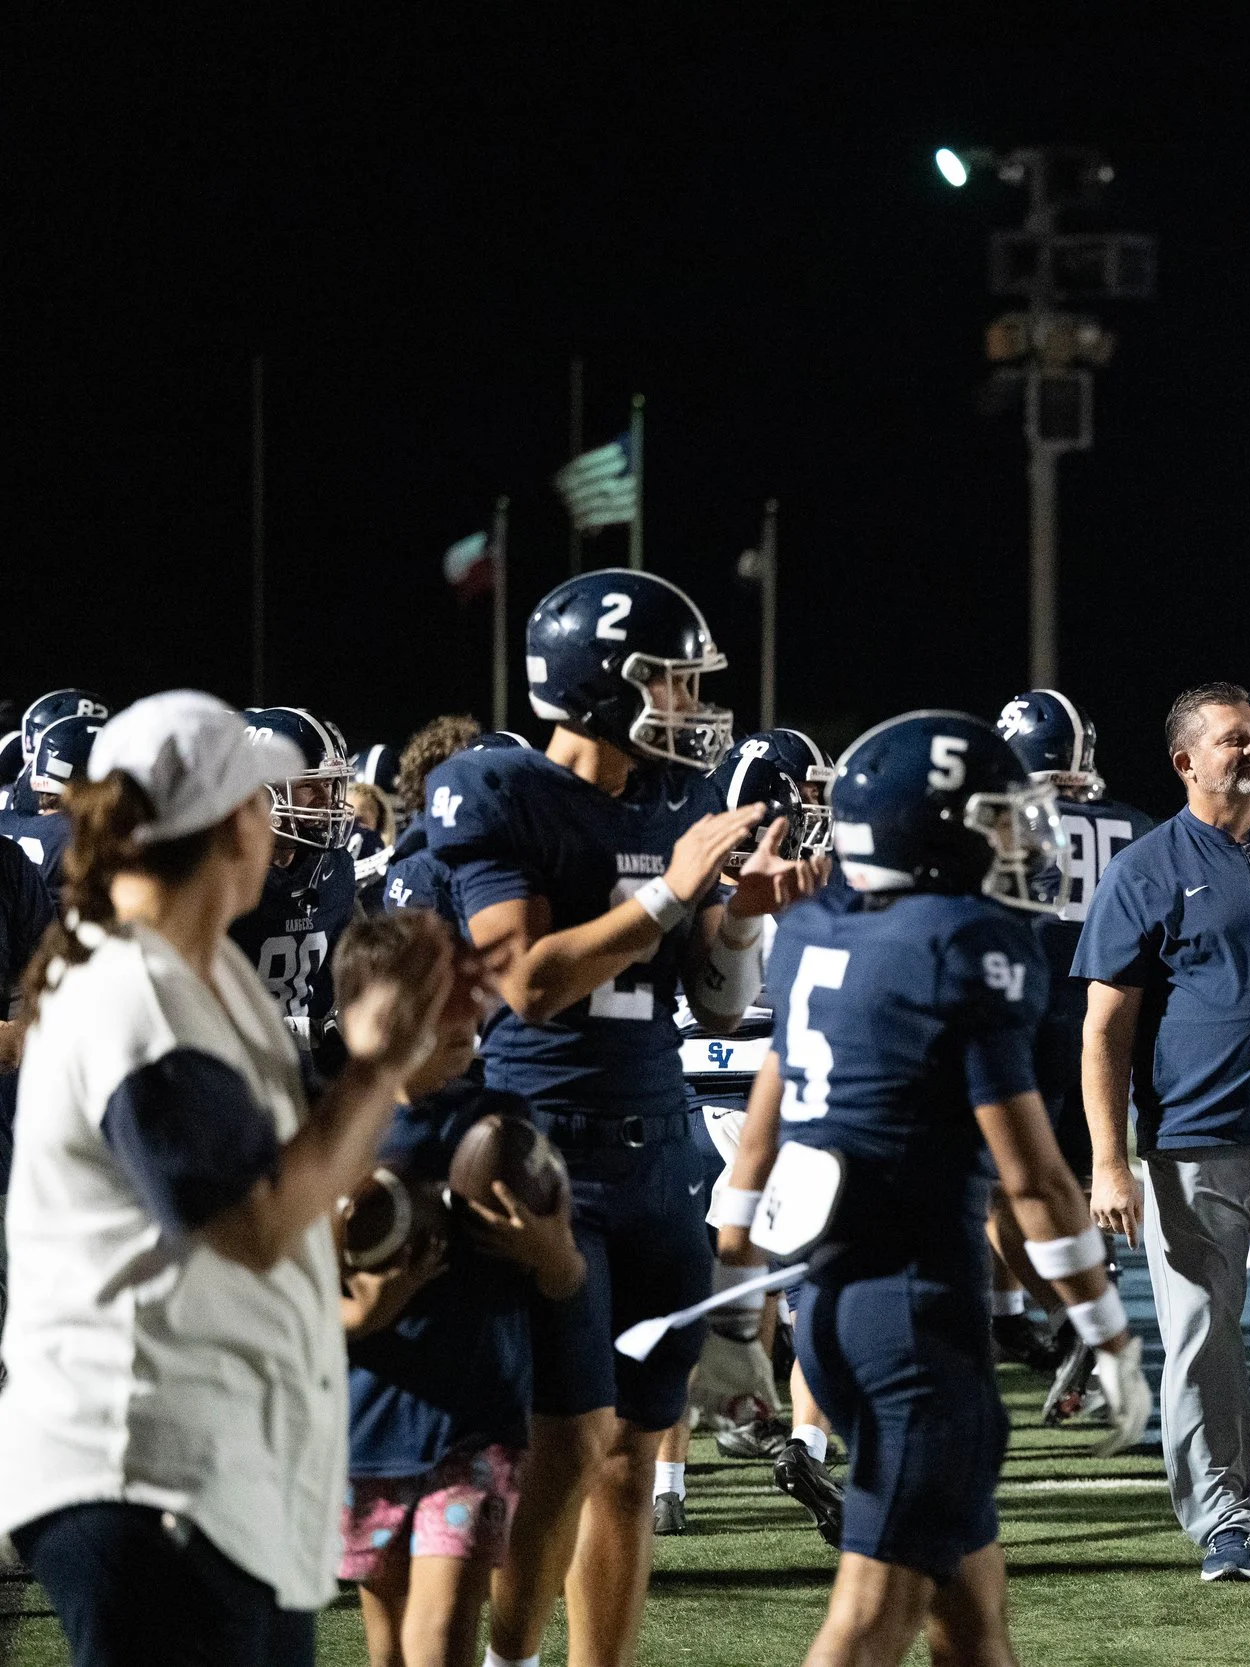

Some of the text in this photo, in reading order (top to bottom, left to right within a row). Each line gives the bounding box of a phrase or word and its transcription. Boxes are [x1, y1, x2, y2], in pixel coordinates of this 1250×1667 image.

[596, 593, 632, 641] 2
[928, 735, 969, 791] 5
[431, 786, 463, 828] SV
[615, 853, 666, 875] RANGERS
[389, 878, 413, 907] SV
[285, 919, 314, 932] RANGERS
[982, 951, 1026, 1001] SV
[780, 945, 850, 1122] 5
[707, 1041, 734, 1069] SV
